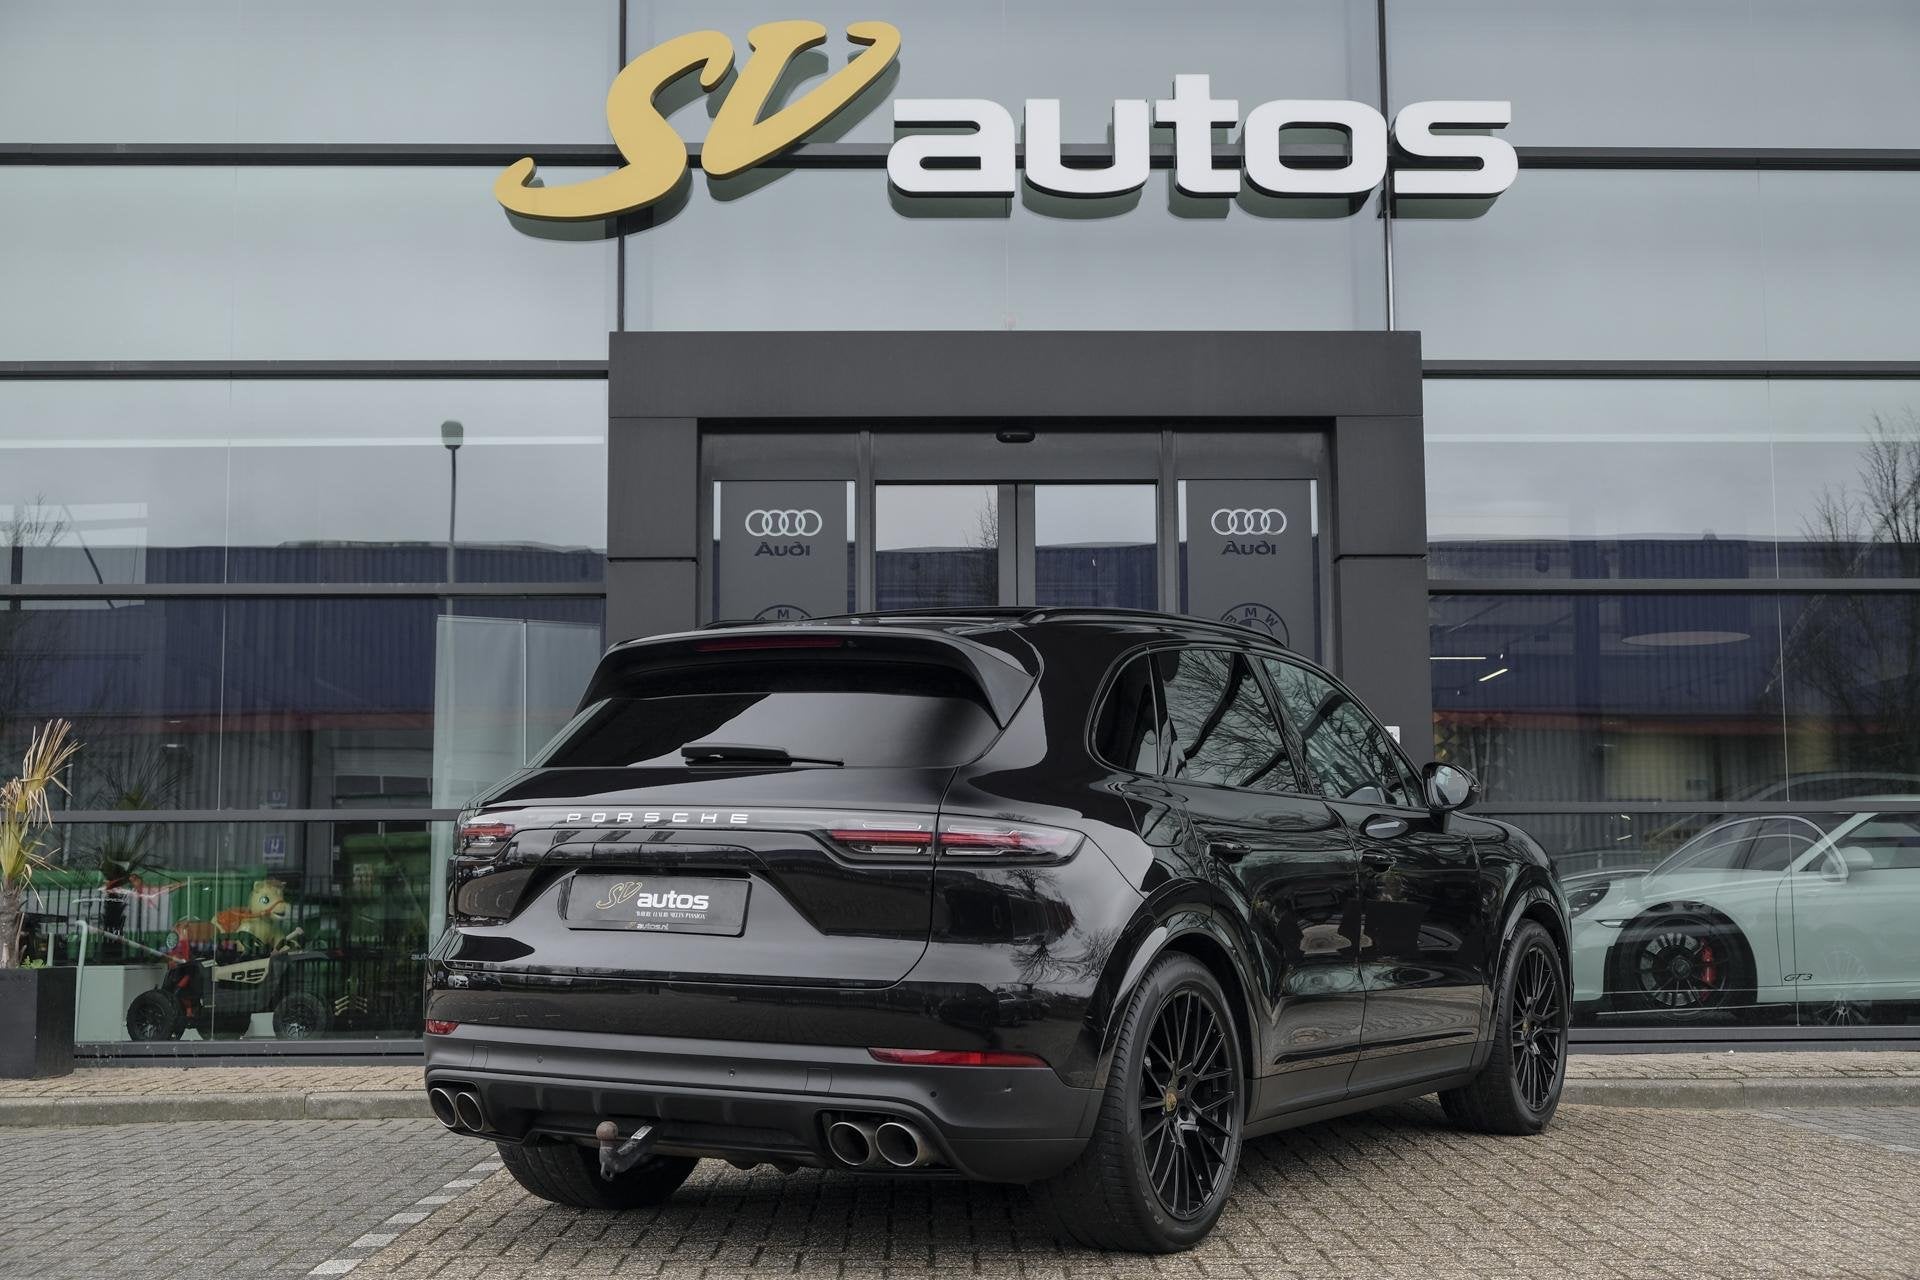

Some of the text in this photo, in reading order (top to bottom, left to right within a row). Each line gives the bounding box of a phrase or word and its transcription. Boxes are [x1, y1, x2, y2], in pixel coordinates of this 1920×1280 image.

[886, 74, 1519, 198] autos
[754, 541, 811, 556] Audi
[1221, 540, 1277, 555] Audi
[566, 812, 749, 824] PORSCHE
[637, 890, 710, 910] autos
[1783, 973, 1813, 982] GT3
